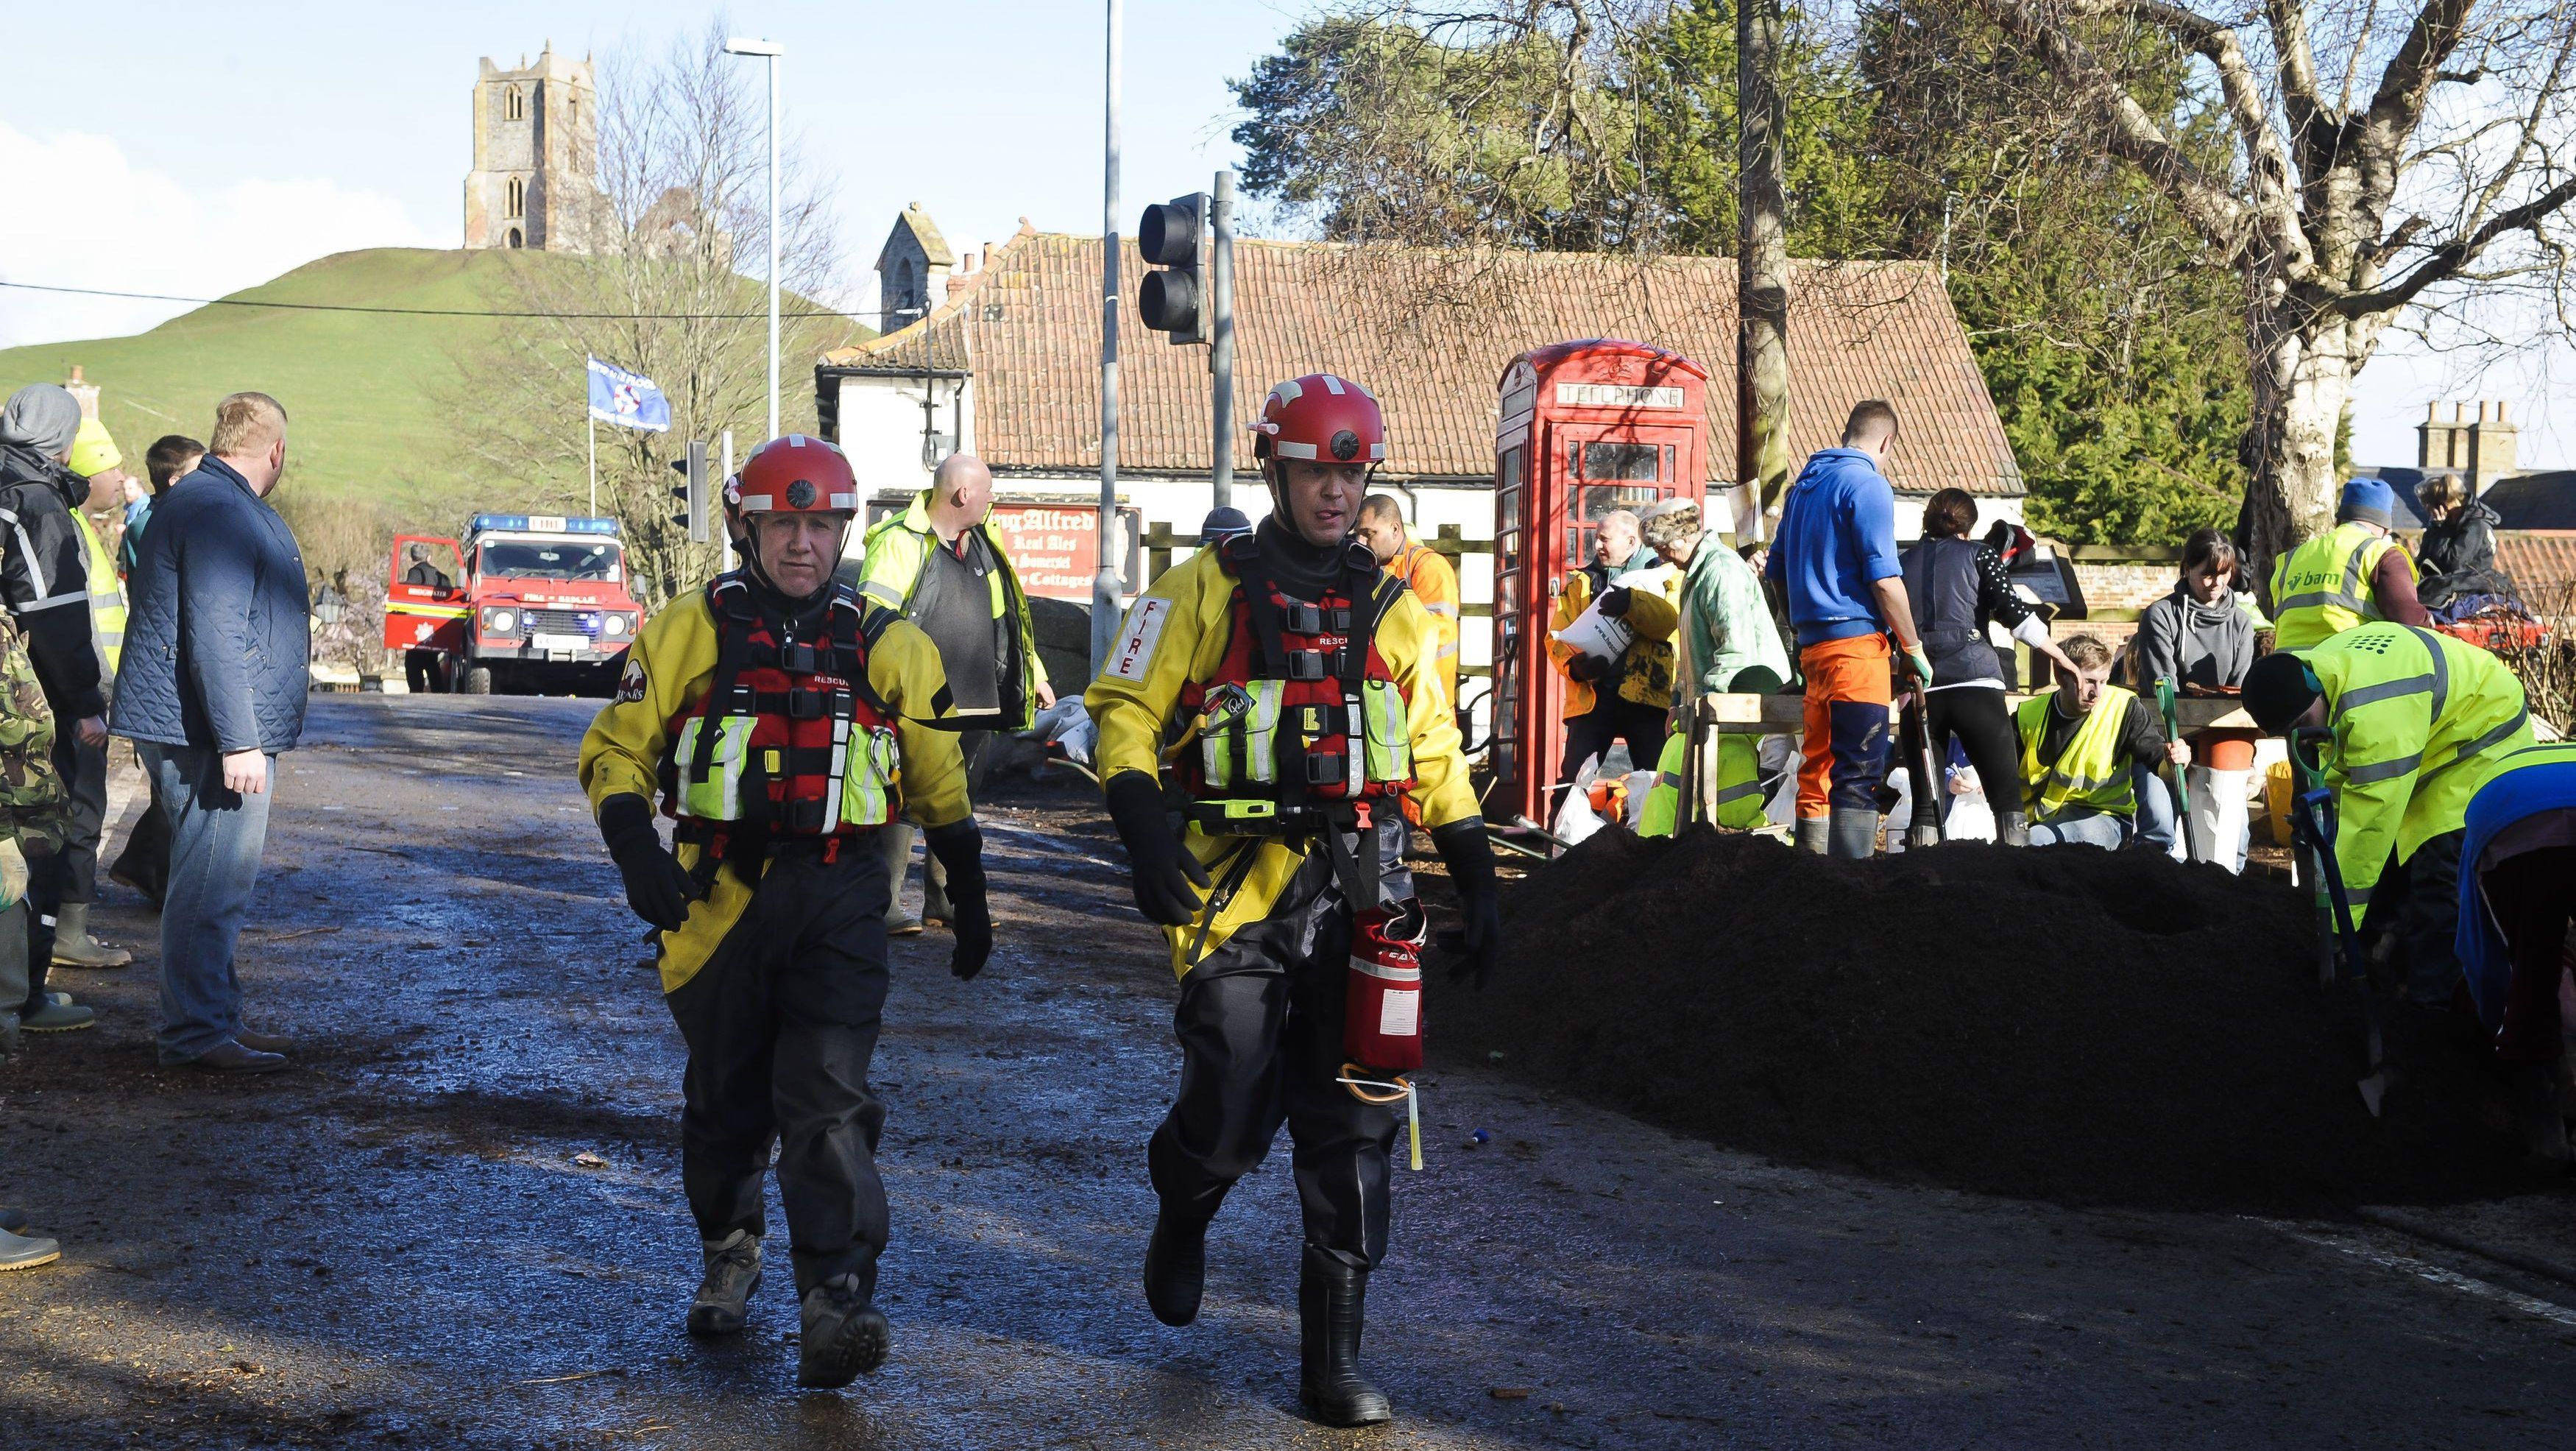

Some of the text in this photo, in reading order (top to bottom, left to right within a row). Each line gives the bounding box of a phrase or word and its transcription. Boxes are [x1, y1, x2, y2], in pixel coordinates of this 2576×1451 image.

[1561, 386, 1679, 406] TELEPHONE
[1023, 509, 1095, 531] Alfred
[1013, 534, 1044, 550] Real
[2303, 571, 2340, 586] bam
[1119, 601, 1157, 674] FIRE
